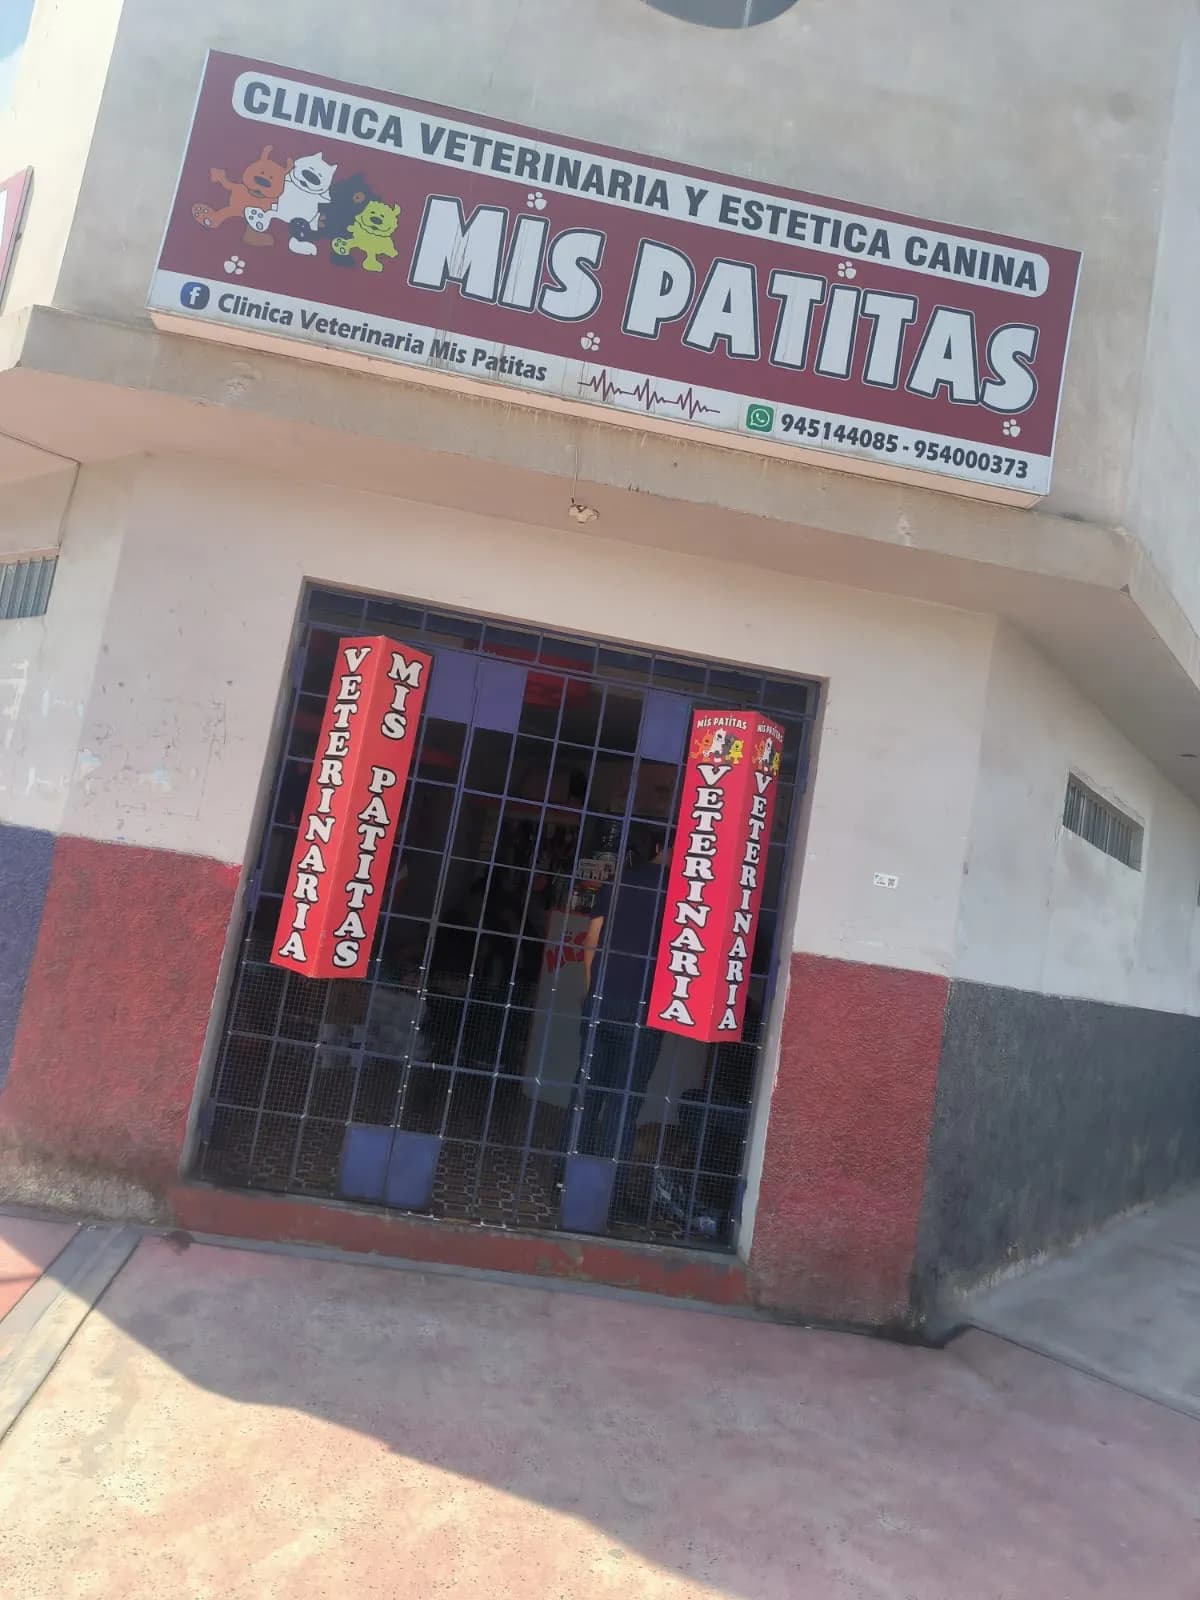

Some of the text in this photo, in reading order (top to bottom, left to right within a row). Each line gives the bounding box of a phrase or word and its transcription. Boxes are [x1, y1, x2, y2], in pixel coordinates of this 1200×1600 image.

[243, 81, 1037, 292] CLINICA VETERINARIA Y ESTETICA CANINA
[217, 292, 293, 327] Clinica
[300, 309, 425, 356] Veterinaria
[429, 338, 467, 364] Mis
[471, 346, 548, 383] Patitas
[781, 413, 899, 453] 945144085
[913, 440, 1029, 480] 954000373
[279, 648, 371, 962] VETERINARIA
[332, 653, 422, 968] MIS PATITAS
[659, 764, 732, 1027] VETERINARIA
[717, 771, 772, 1031] VETERINARIA
